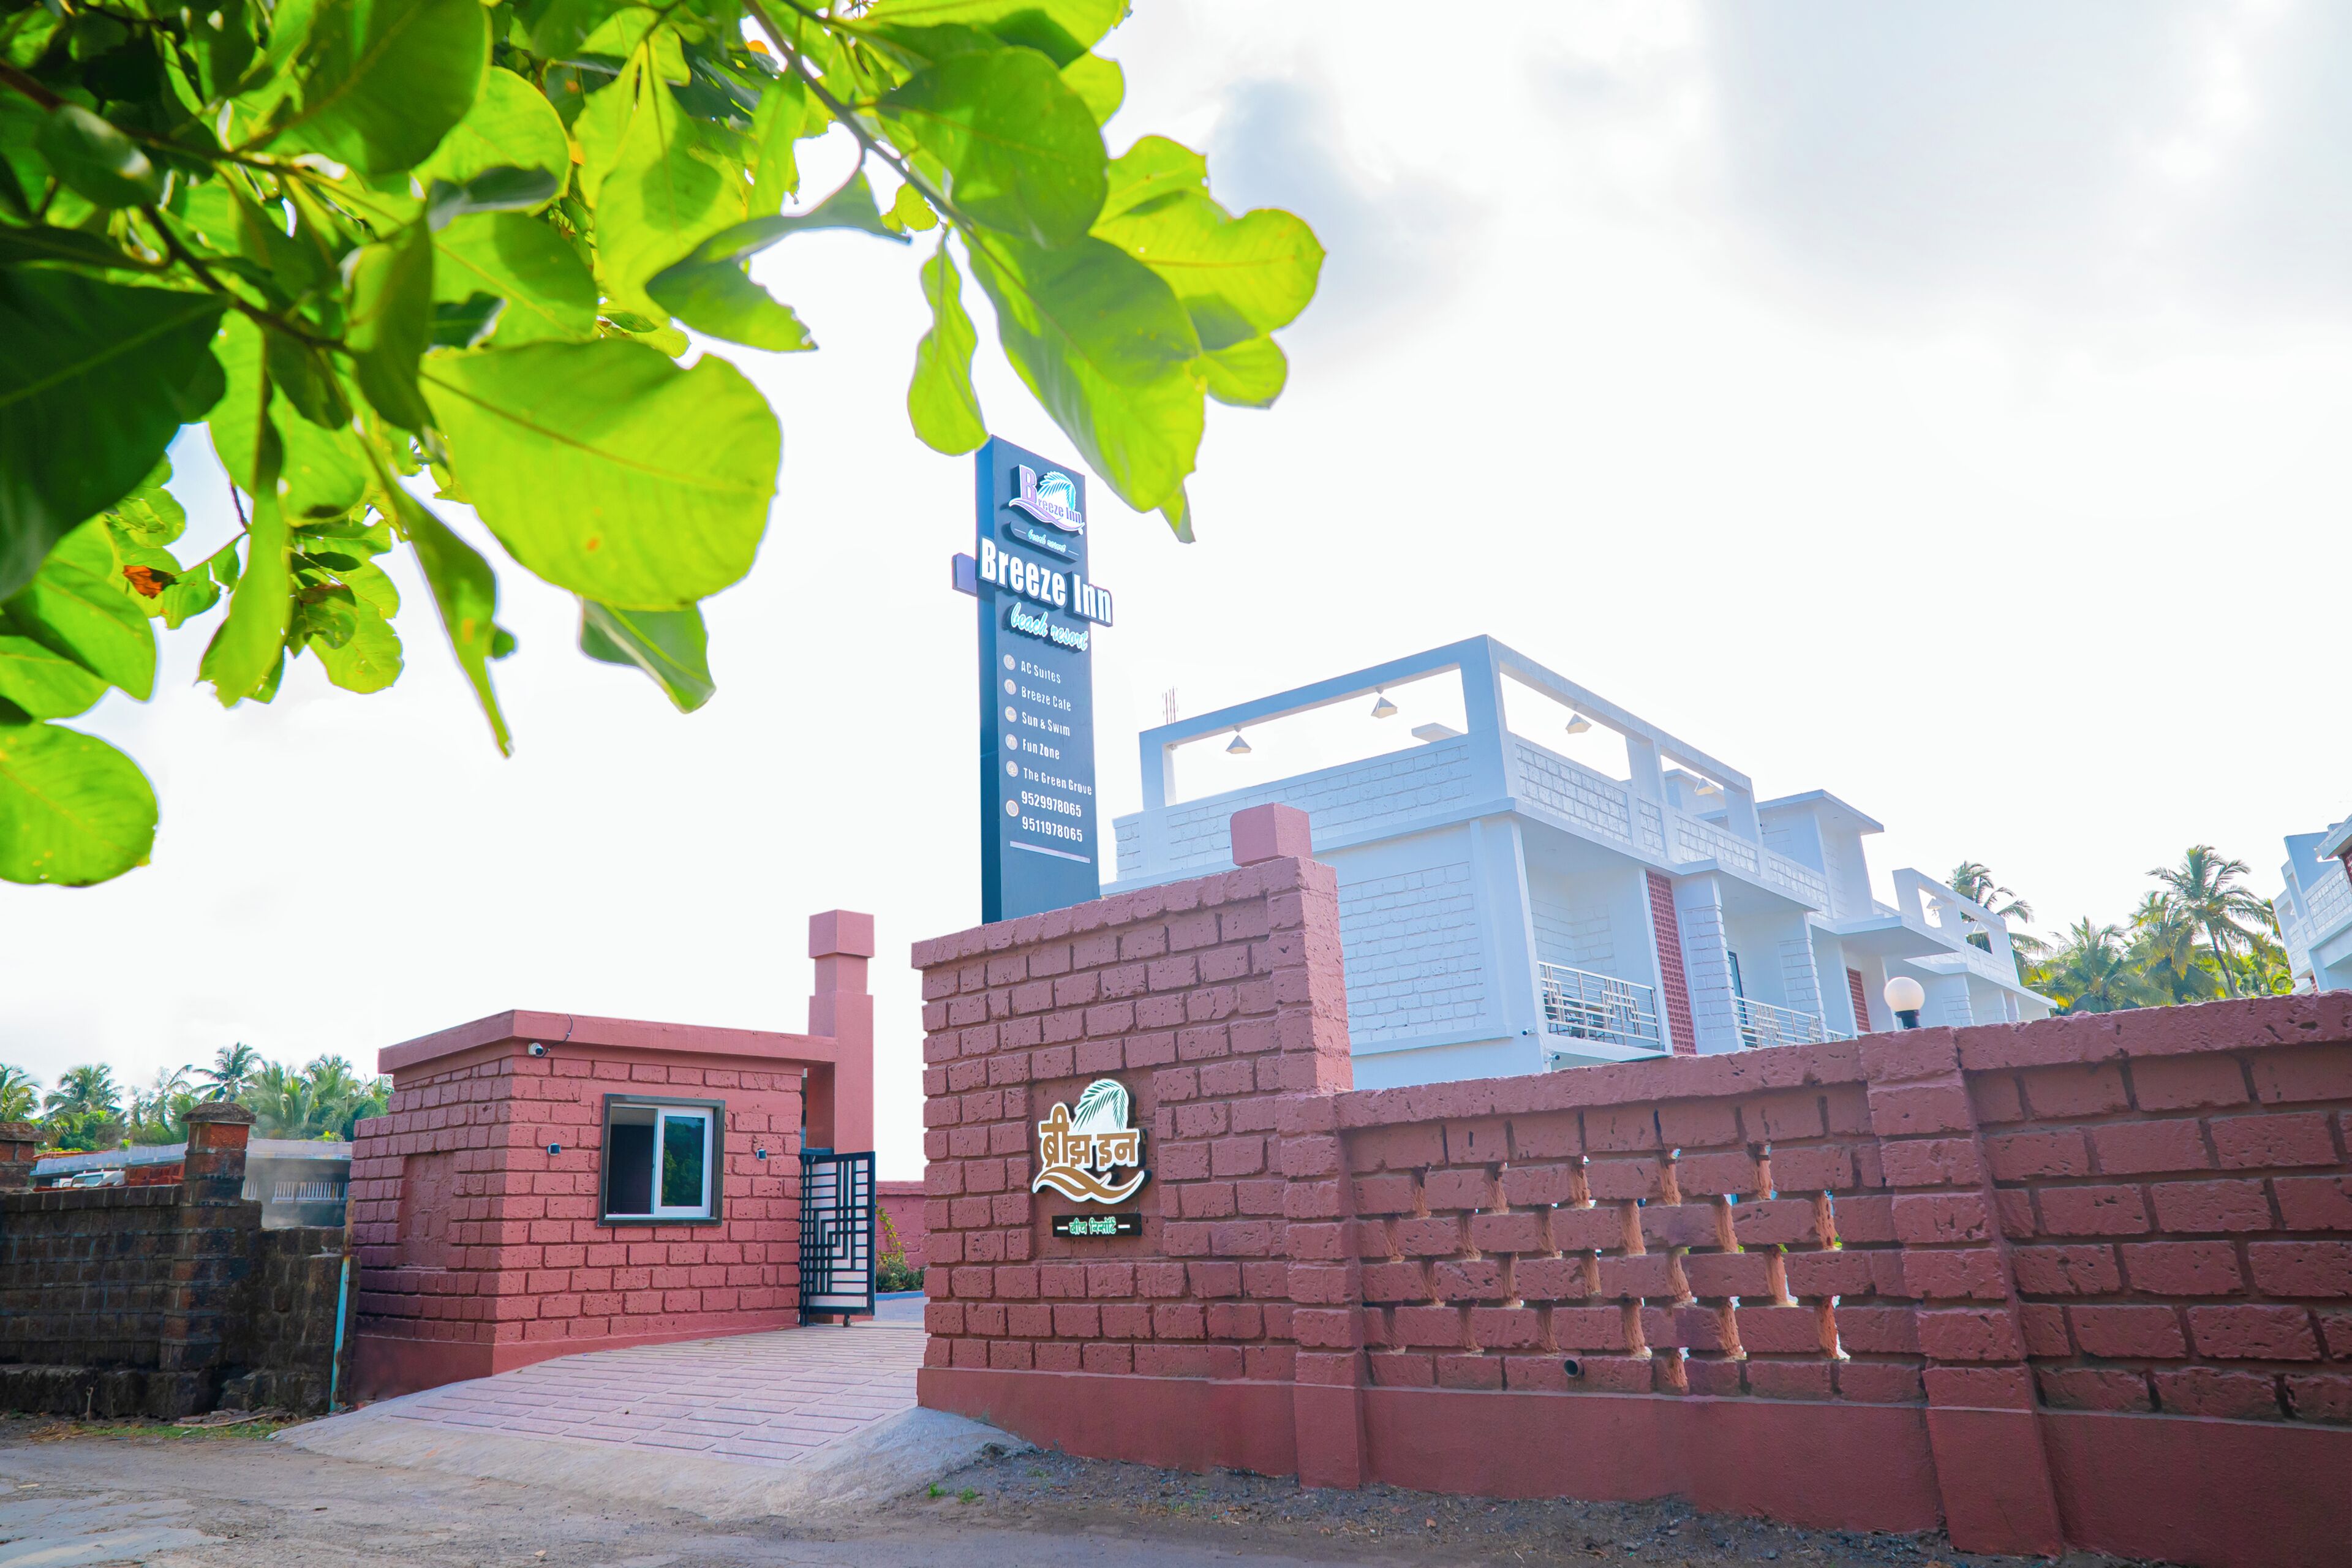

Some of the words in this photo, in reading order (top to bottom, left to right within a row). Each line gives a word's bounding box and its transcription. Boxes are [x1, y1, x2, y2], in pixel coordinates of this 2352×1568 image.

[1020, 466, 1064, 516] Breeze
[1066, 510, 1082, 524] Inn
[1028, 529, 1046, 545] beach
[1047, 539, 1066, 553] resort
[982, 537, 1066, 608] Breeze
[1074, 574, 1112, 624] Inn
[1011, 602, 1048, 636] beach
[1050, 625, 1088, 651] resort
[1021, 660, 1031, 674] AC
[1034, 665, 1061, 684] Suites
[1022, 686, 1050, 705] Breeze
[1022, 712, 1038, 728] Sun
[1040, 718, 1046, 729] &
[1048, 720, 1070, 736] Swim
[1023, 739, 1038, 754] Fun
[1040, 744, 1060, 760] Zone
[1023, 768, 1038, 782] The
[1041, 773, 1066, 788] Green
[1069, 780, 1091, 795] Grove
[1021, 791, 1081, 817] 9529978065
[1022, 816, 1082, 842] 9511978065
[1041, 1106, 1091, 1167] ब्रीझ
[1096, 1132, 1137, 1166] इन
[1069, 1218, 1087, 1234] बीच
